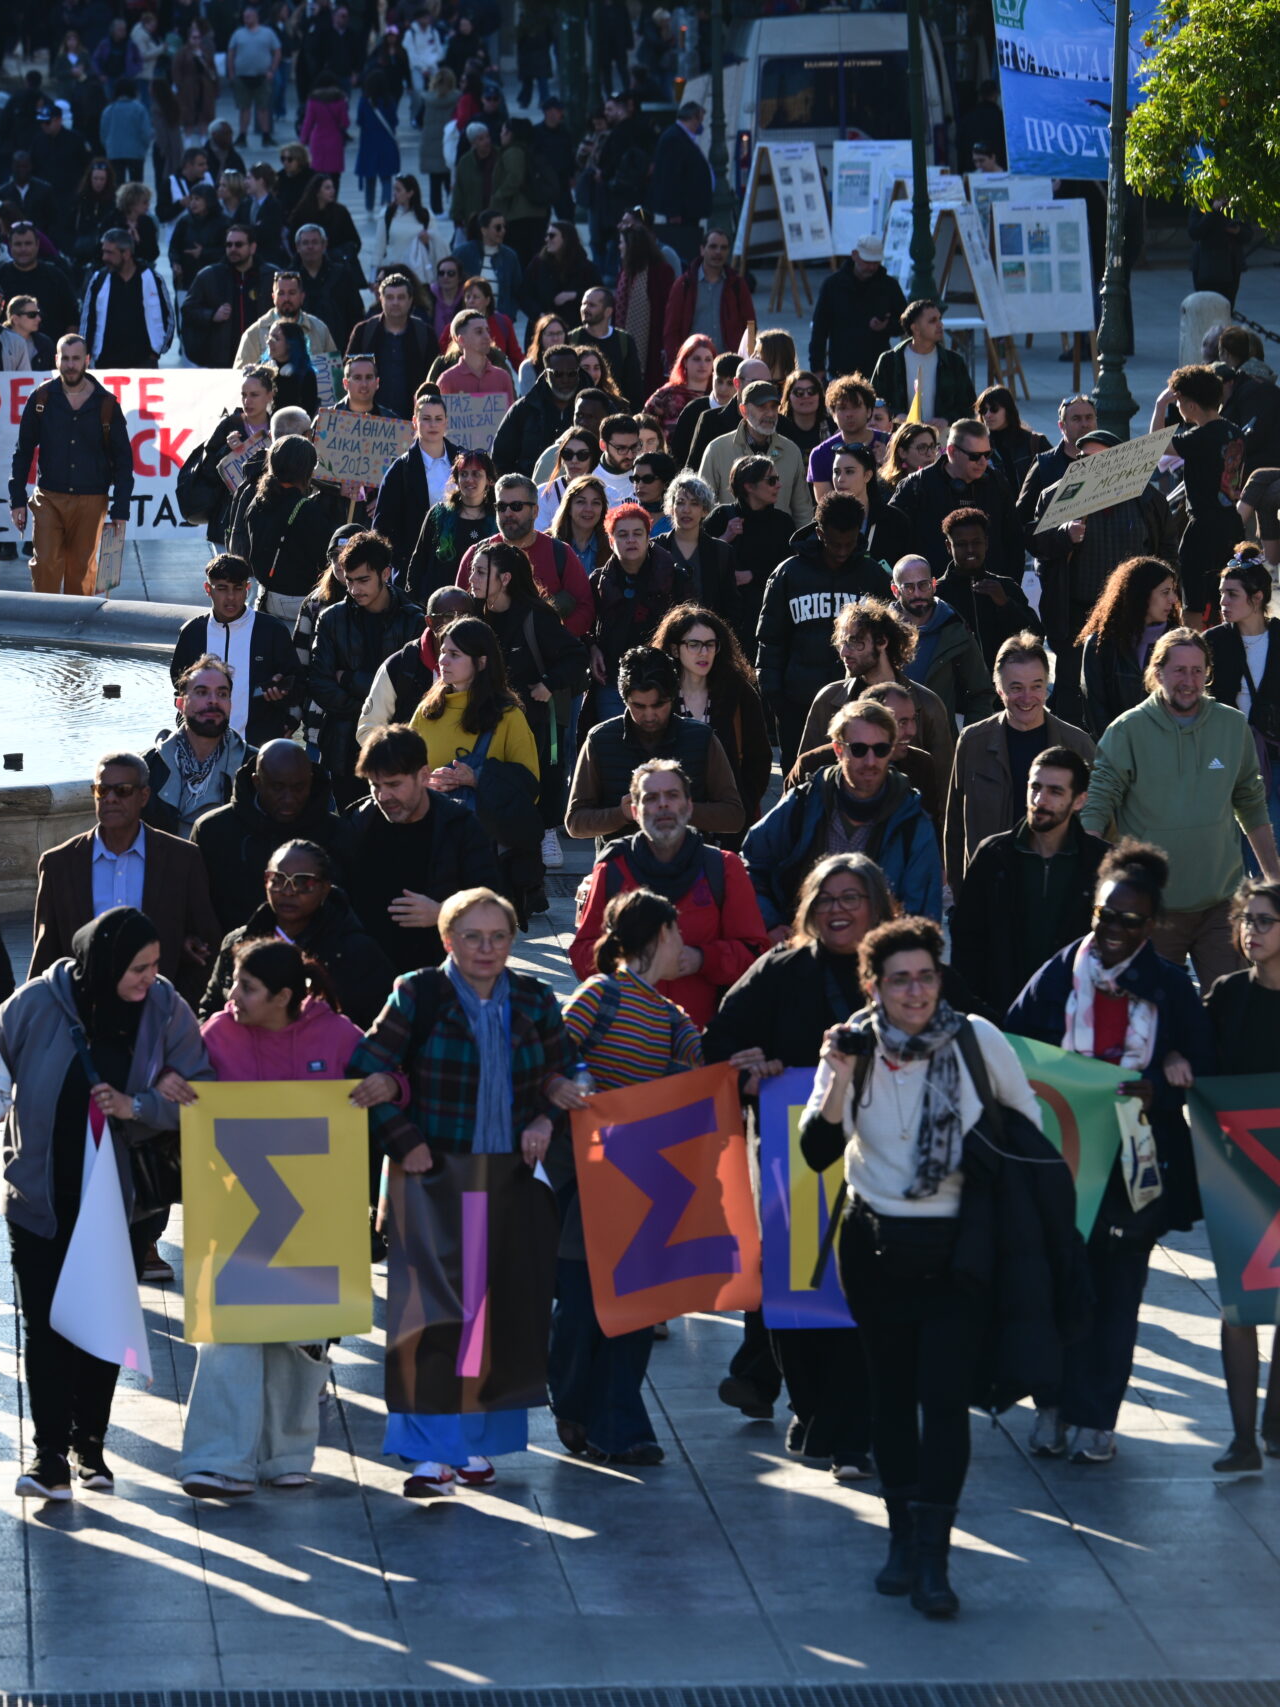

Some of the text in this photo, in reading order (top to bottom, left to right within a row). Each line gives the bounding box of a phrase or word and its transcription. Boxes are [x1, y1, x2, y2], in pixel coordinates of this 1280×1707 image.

[1023, 116, 1111, 158] ΠΡΟΣΤ
[326, 414, 396, 439] Η ΑΘΗΝΑ
[326, 436, 399, 457] ΔΙΚΙΑ ΜΑΣ
[338, 455, 370, 476] 2013
[789, 592, 869, 624] ORIGIN
